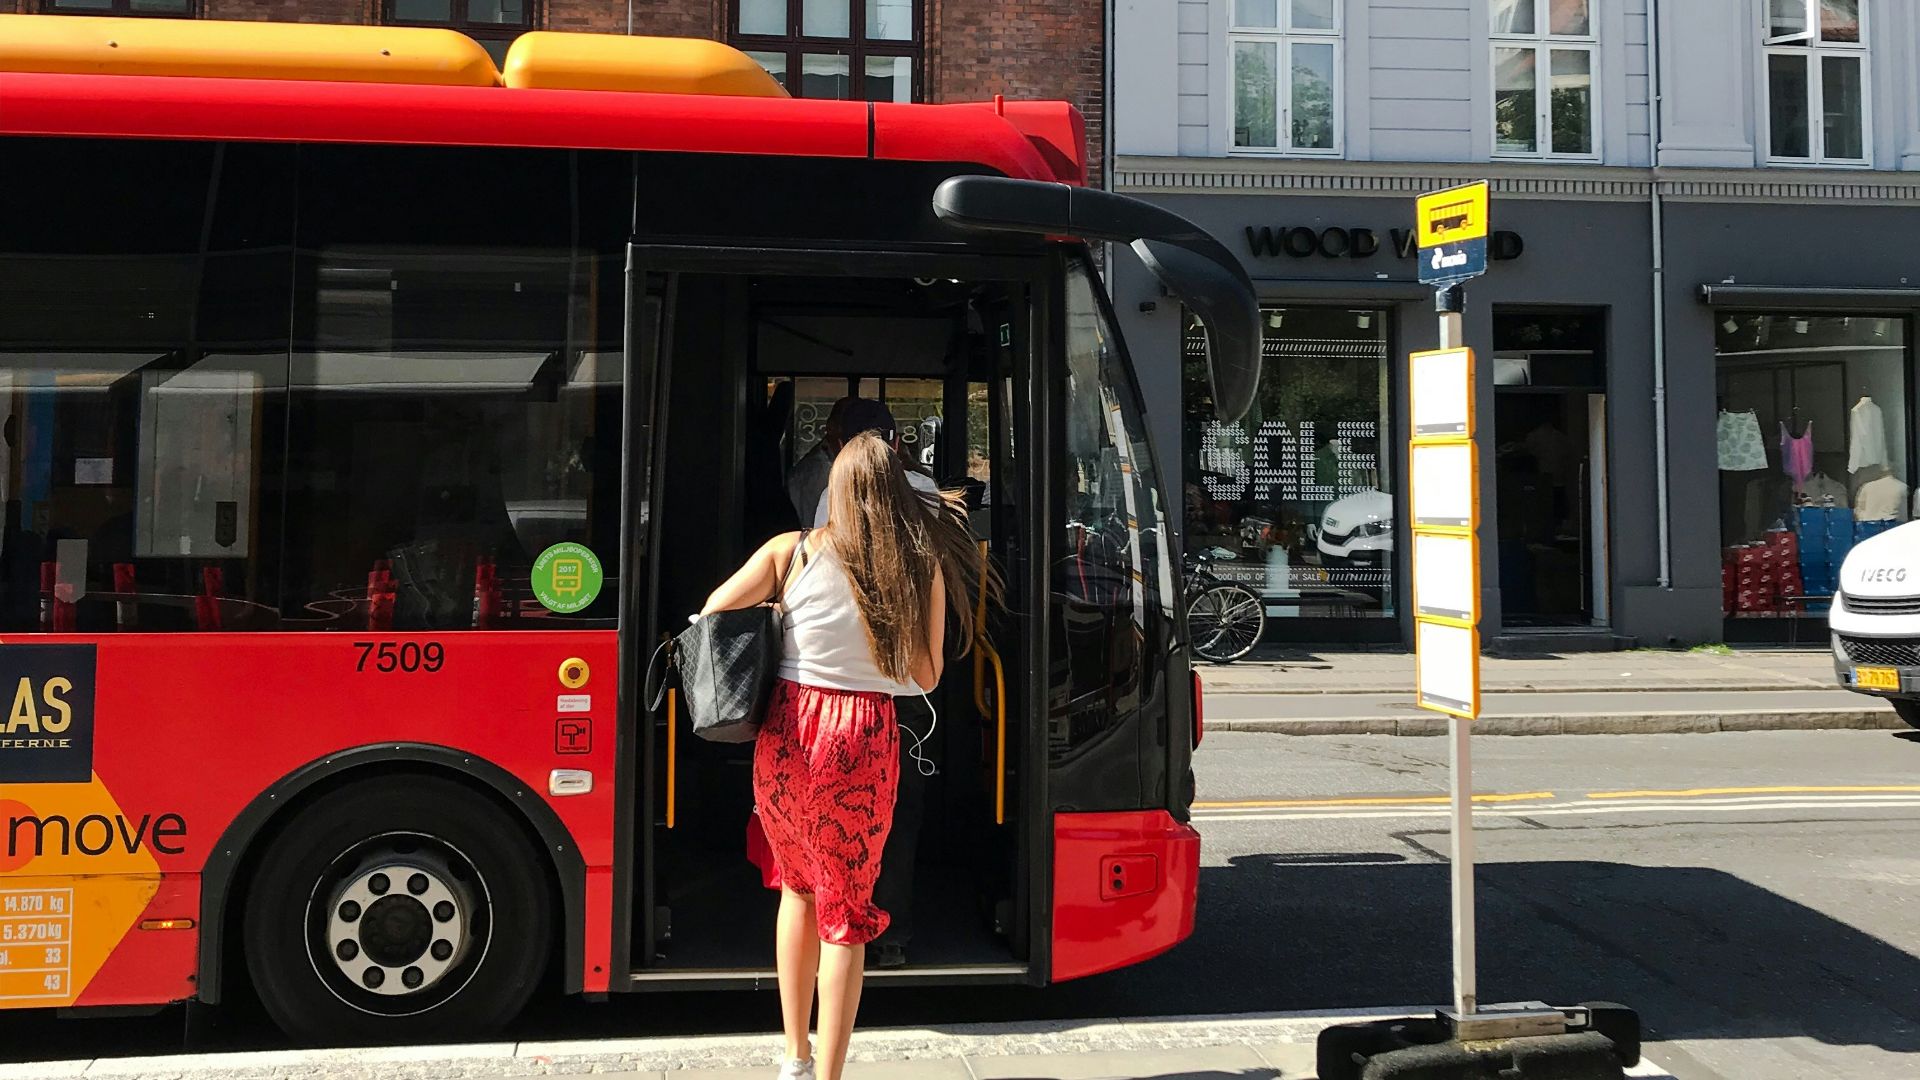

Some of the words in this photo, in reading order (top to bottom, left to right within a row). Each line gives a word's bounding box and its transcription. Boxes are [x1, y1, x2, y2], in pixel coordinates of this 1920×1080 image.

[1245, 226, 1379, 258] WOOD
[1391, 228, 1523, 260] WD
[1202, 420, 1376, 500] SALE
[558, 565, 577, 573] 2017
[1236, 573, 1251, 581] END
[1255, 573, 1265, 581] OF
[1302, 574, 1321, 582] SALE
[1860, 567, 1907, 582] IVECO
[353, 641, 445, 673] 7509
[0, 676, 73, 733] AS
[8, 813, 187, 856] move
[4, 896, 43, 912] 14.870
[50, 896, 64, 912] kg
[3, 924, 47, 940] 5.370
[48, 922, 62, 938] kg
[45, 948, 61, 964] 33
[44, 975, 61, 990] 43
